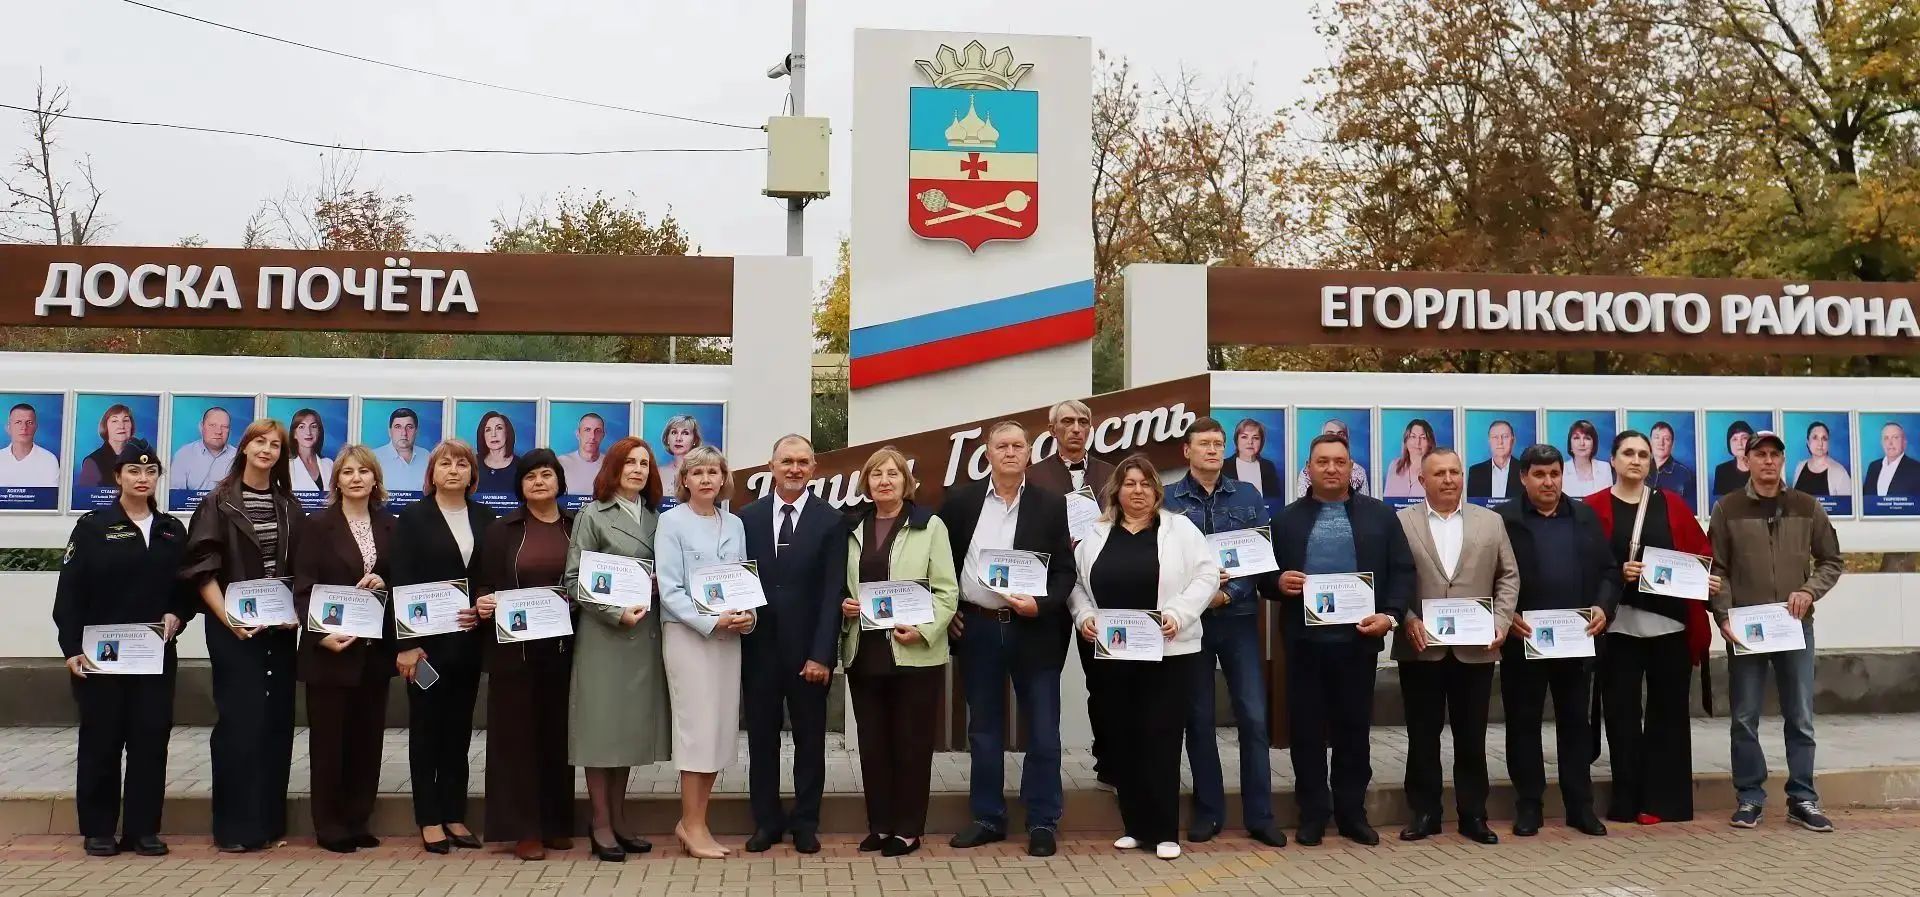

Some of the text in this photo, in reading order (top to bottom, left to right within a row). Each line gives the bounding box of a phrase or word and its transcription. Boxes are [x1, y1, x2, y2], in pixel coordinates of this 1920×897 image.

[34, 256, 479, 318] ДОСКА ПОЧЁТА
[1320, 284, 1920, 338] ЕГОРЛЫКСКОГО РАЙОНА
